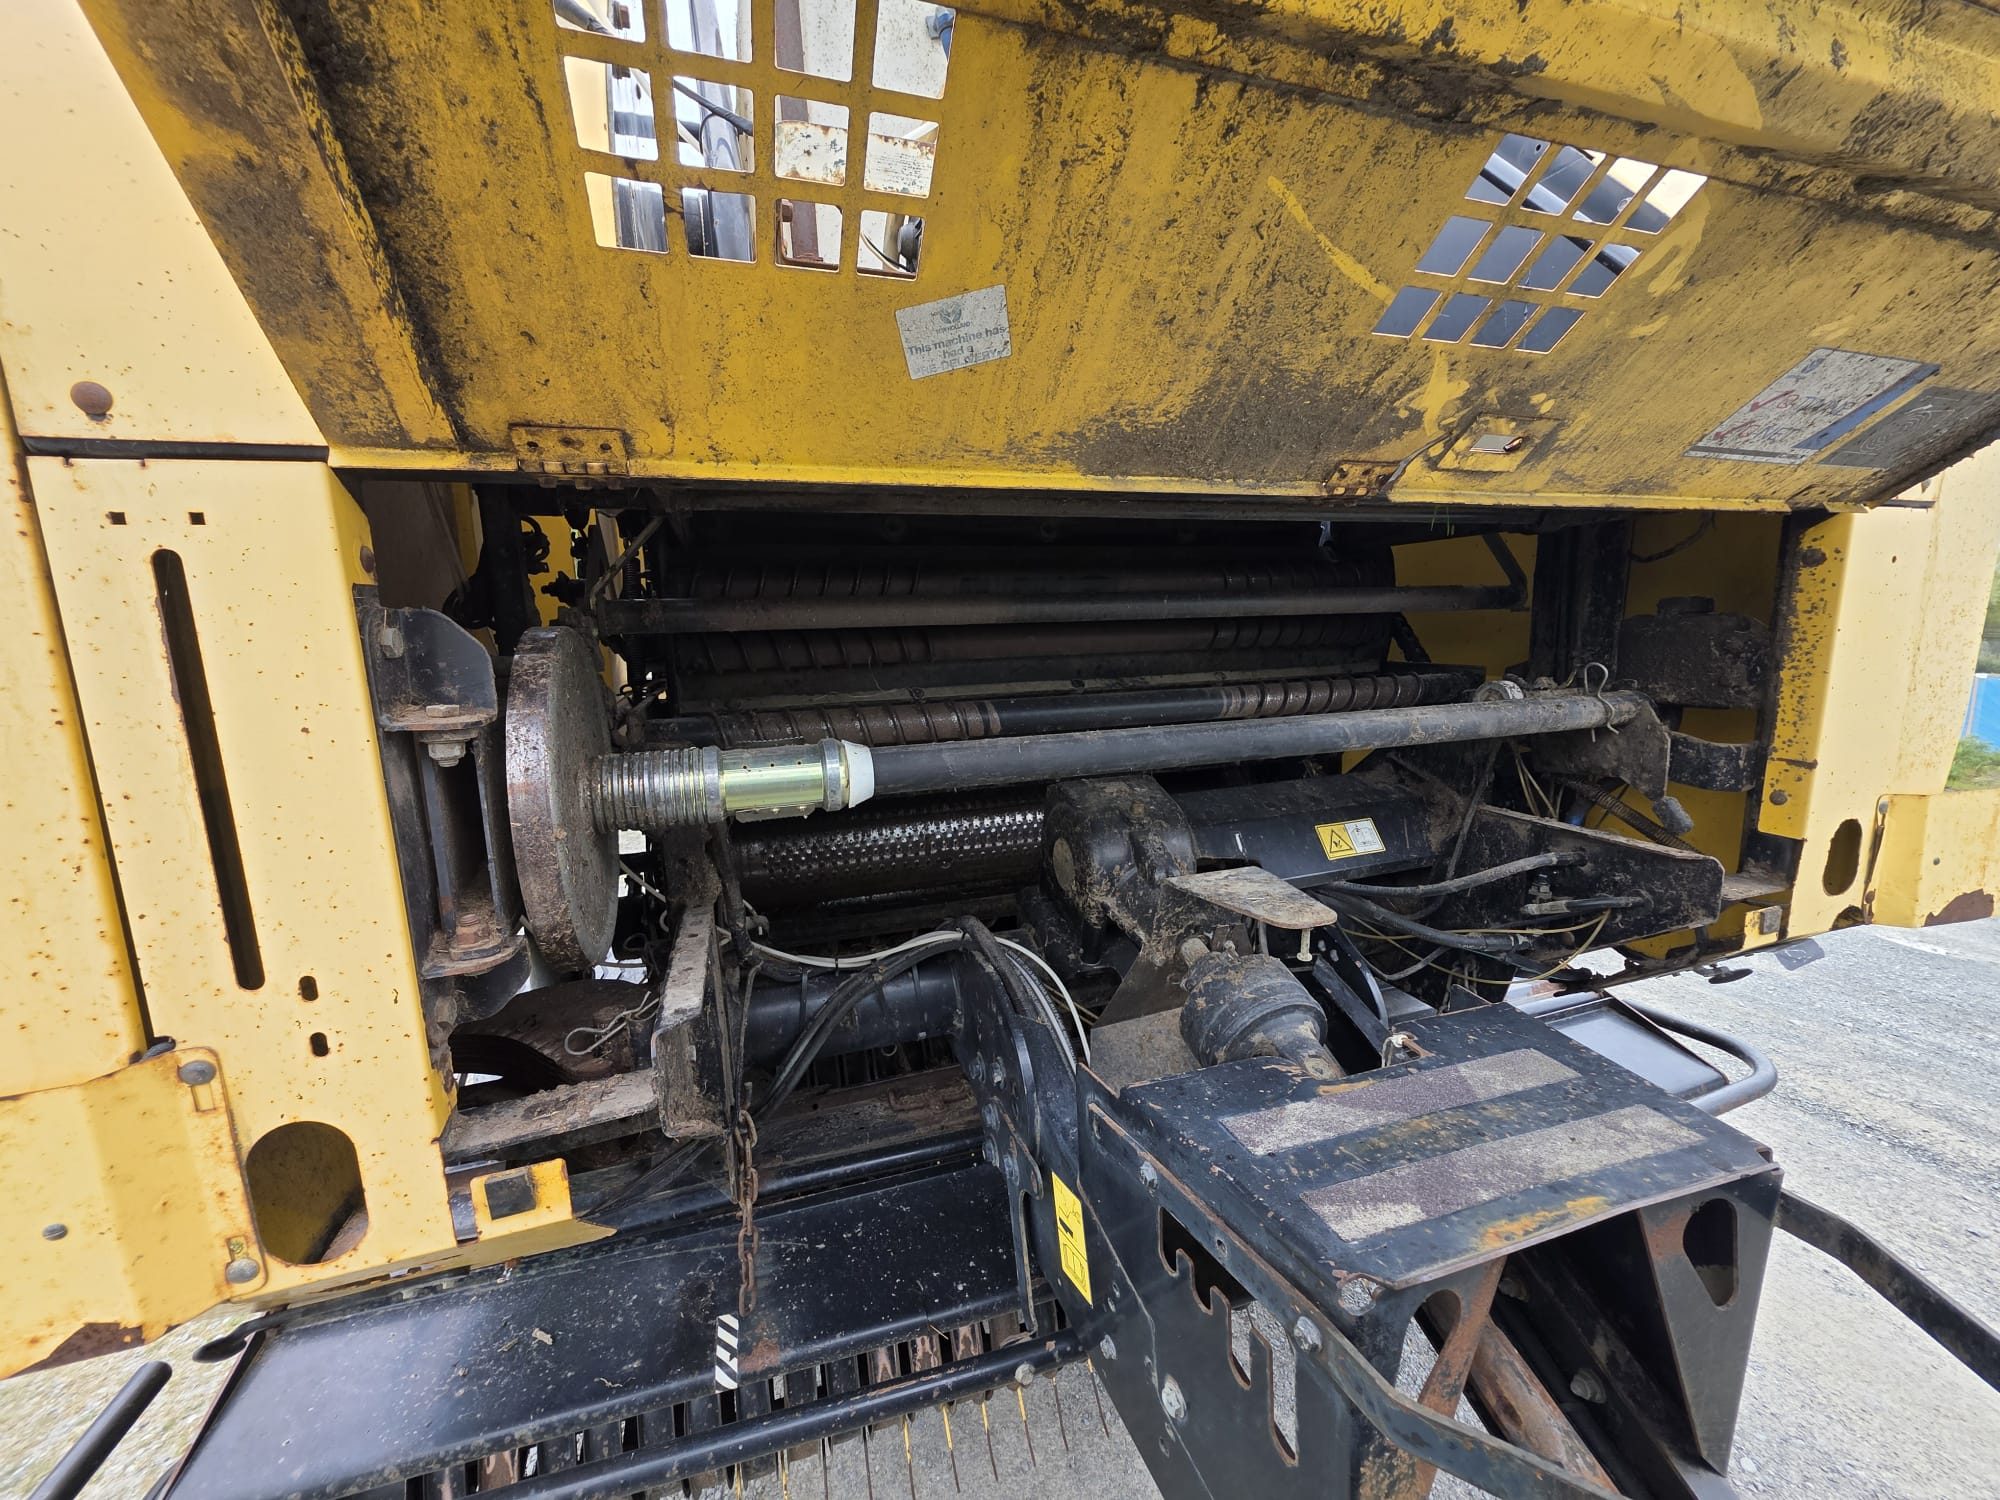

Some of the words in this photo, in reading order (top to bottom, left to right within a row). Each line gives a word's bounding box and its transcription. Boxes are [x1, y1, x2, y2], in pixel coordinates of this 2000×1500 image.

[908, 343, 932, 356] This
[933, 331, 982, 350] machine
[984, 325, 1006, 337] has
[942, 345, 965, 359] had
